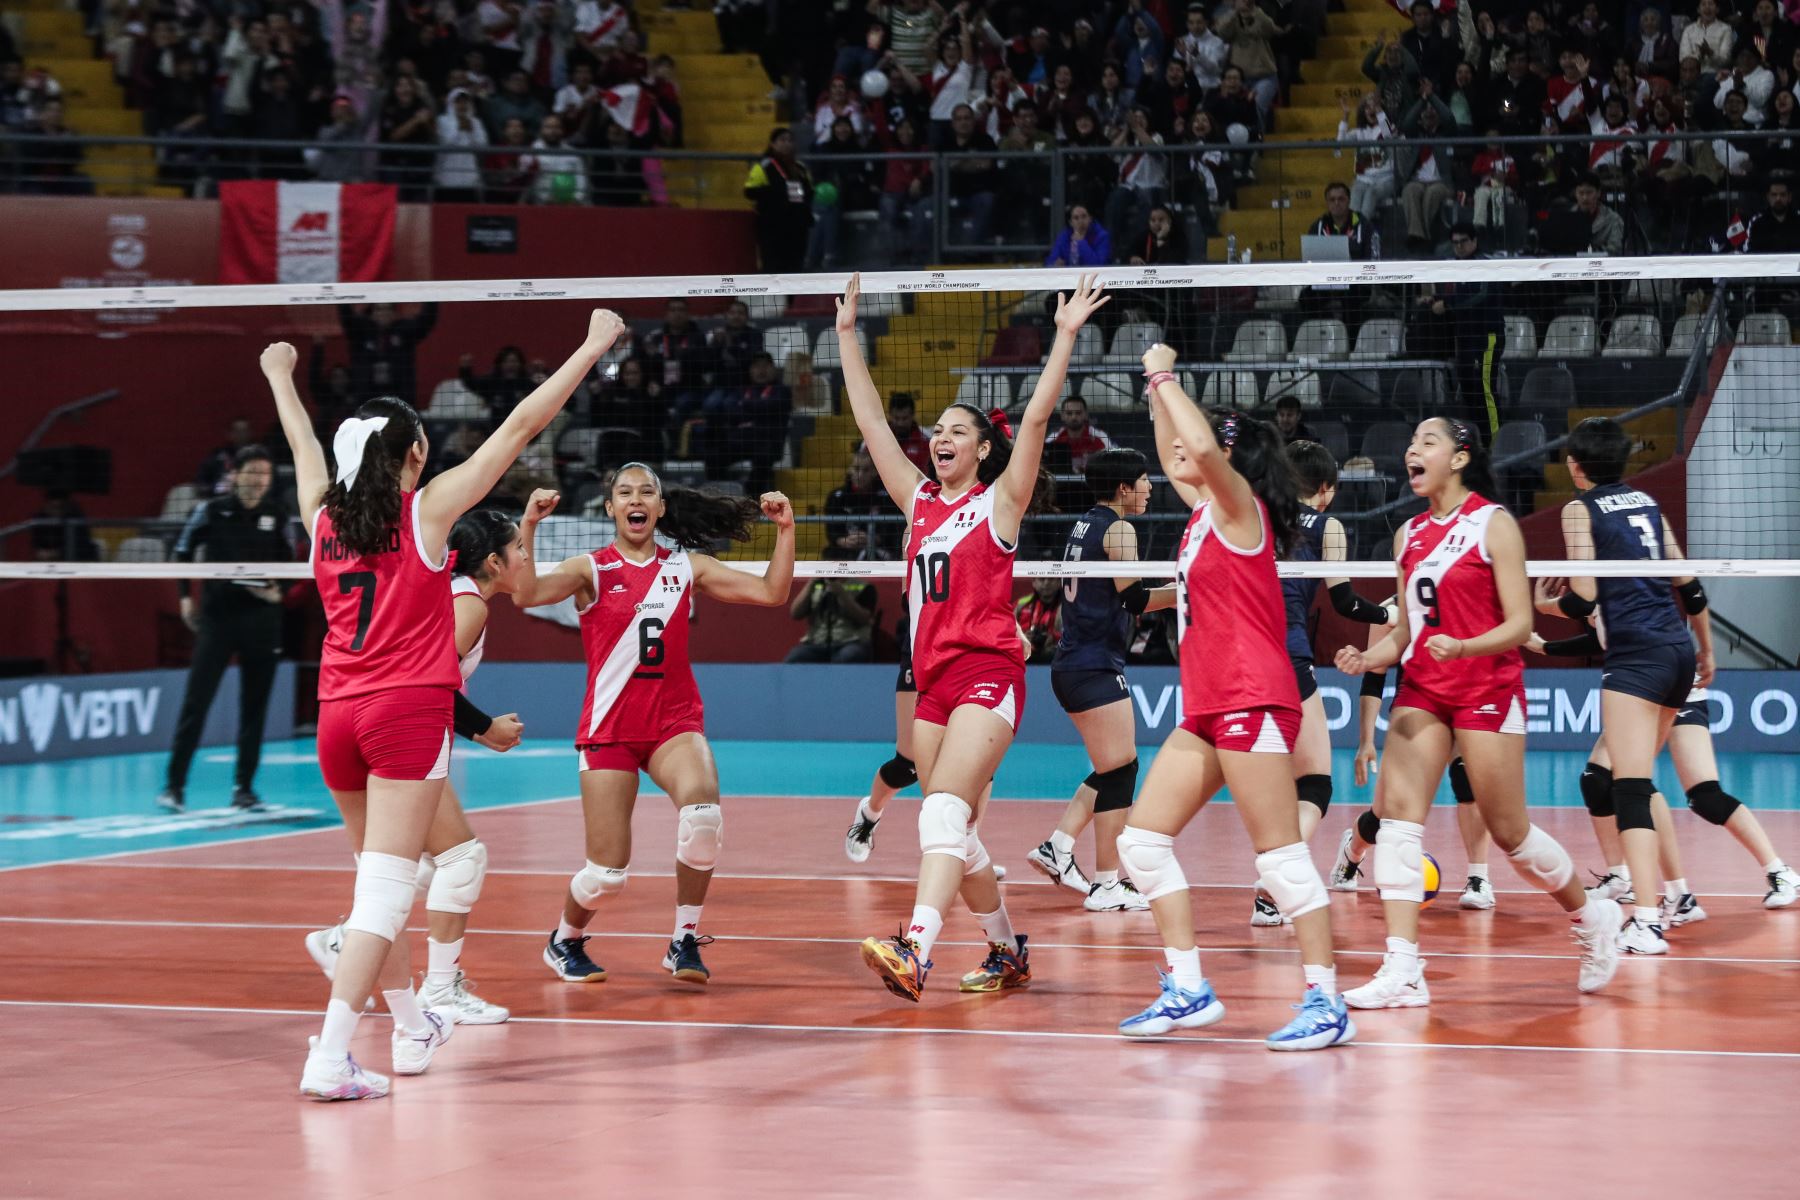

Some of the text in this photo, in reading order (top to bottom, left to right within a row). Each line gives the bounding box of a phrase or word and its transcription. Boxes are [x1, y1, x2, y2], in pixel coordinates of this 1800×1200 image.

[1071, 520, 1091, 540] TOKI
[915, 552, 950, 604] 10
[1416, 577, 1440, 628] 9
[338, 570, 378, 650] 7
[638, 617, 665, 666] 6
[904, 669, 912, 684] 6
[62, 686, 161, 740] VBTV
